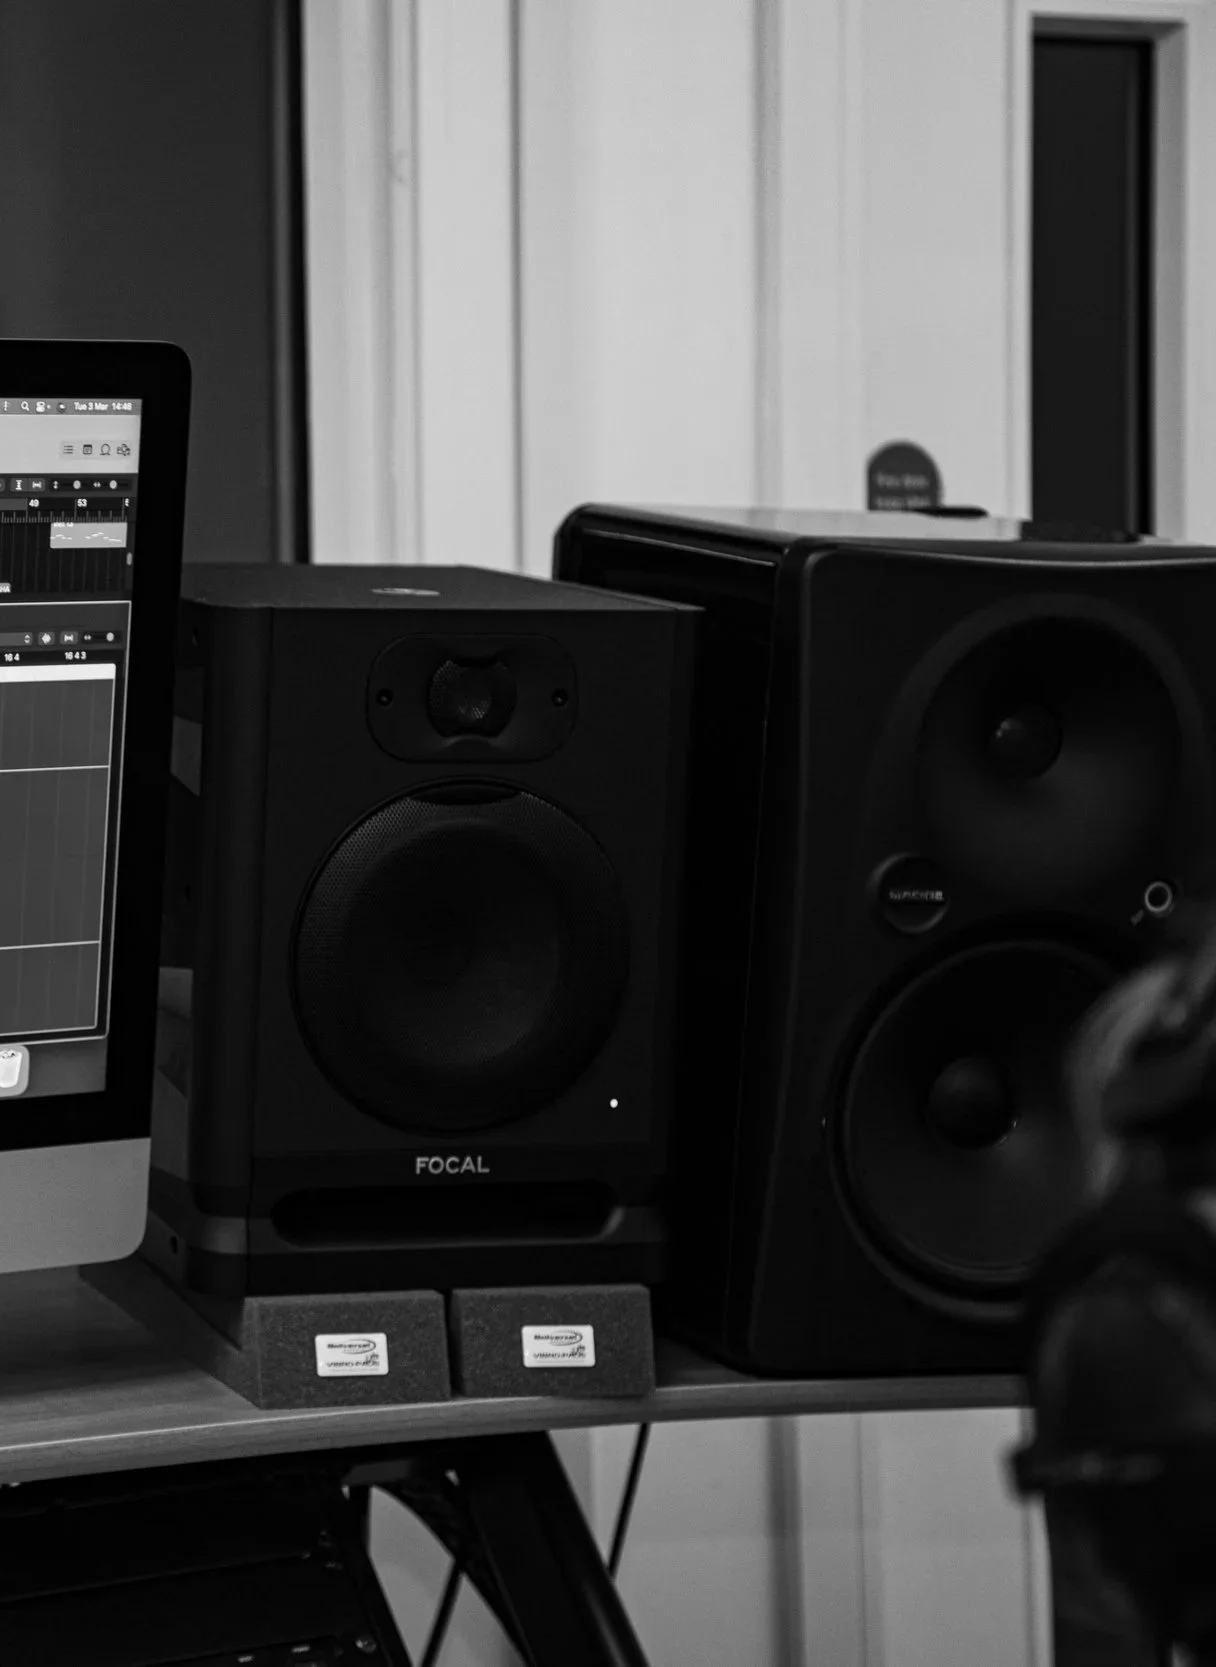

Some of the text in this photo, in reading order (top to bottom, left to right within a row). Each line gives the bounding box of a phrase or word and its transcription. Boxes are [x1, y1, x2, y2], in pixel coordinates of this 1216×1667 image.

[28, 498, 40, 508] 49
[77, 498, 88, 507] 53
[415, 1155, 490, 1175] FOCAL
